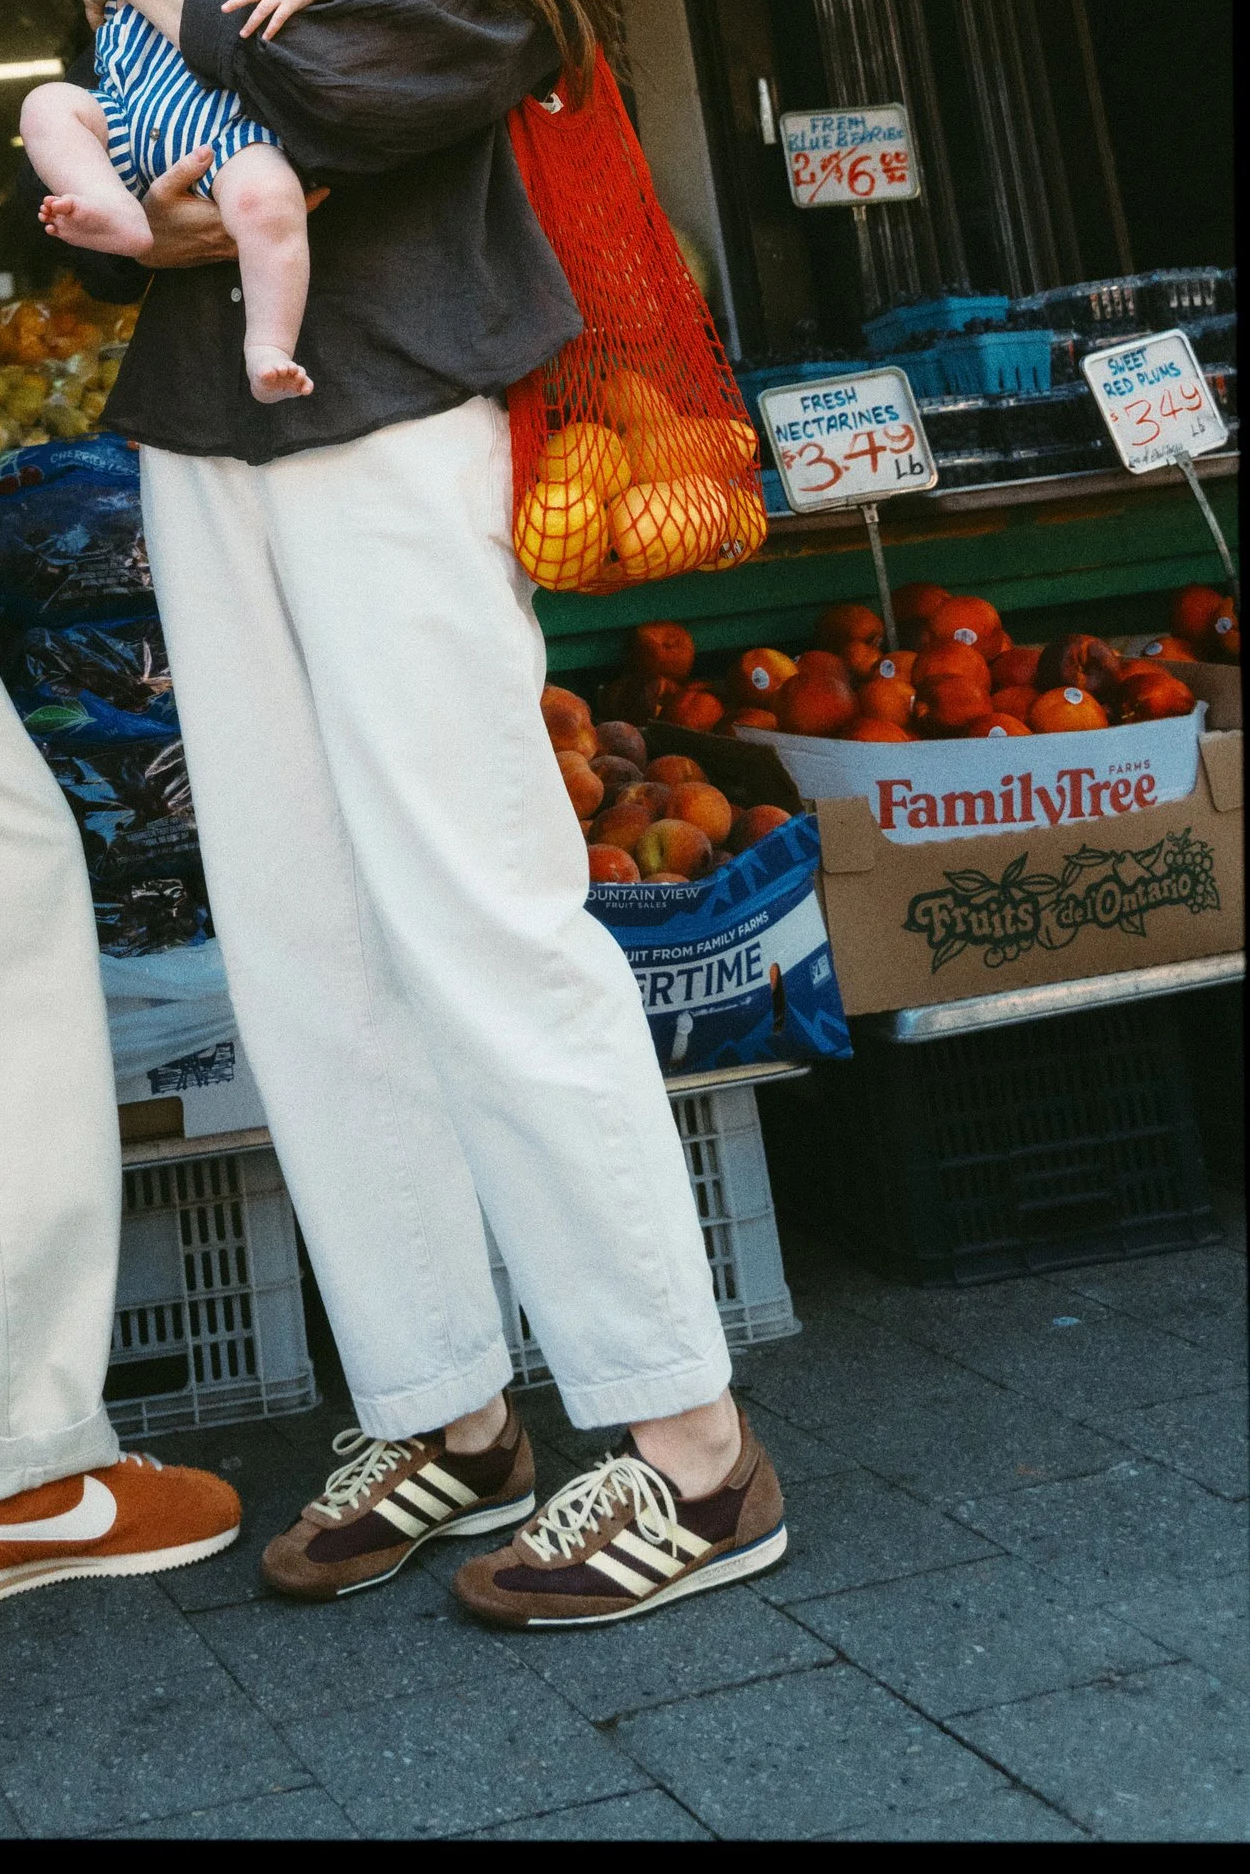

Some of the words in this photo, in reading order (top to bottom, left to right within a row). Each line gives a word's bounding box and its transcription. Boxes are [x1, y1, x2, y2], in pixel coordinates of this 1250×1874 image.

[810, 116, 866, 134] FRESH
[1107, 347, 1148, 376] SWEET
[1102, 377, 1134, 399] RED
[1136, 361, 1182, 387] PLUMS
[801, 386, 859, 414] FRESH
[775, 404, 900, 443] NECTARINES
[1108, 759, 1151, 776] FARMS
[875, 767, 1159, 830] FamilyTree
[605, 901, 634, 910] FRUIT
[637, 901, 668, 909] SALES
[660, 887, 701, 900] VIEW
[916, 896, 1035, 941] Fruits
[652, 945, 694, 961] FROM
[696, 929, 737, 952] FAMILY
[737, 910, 770, 937] FARMS
